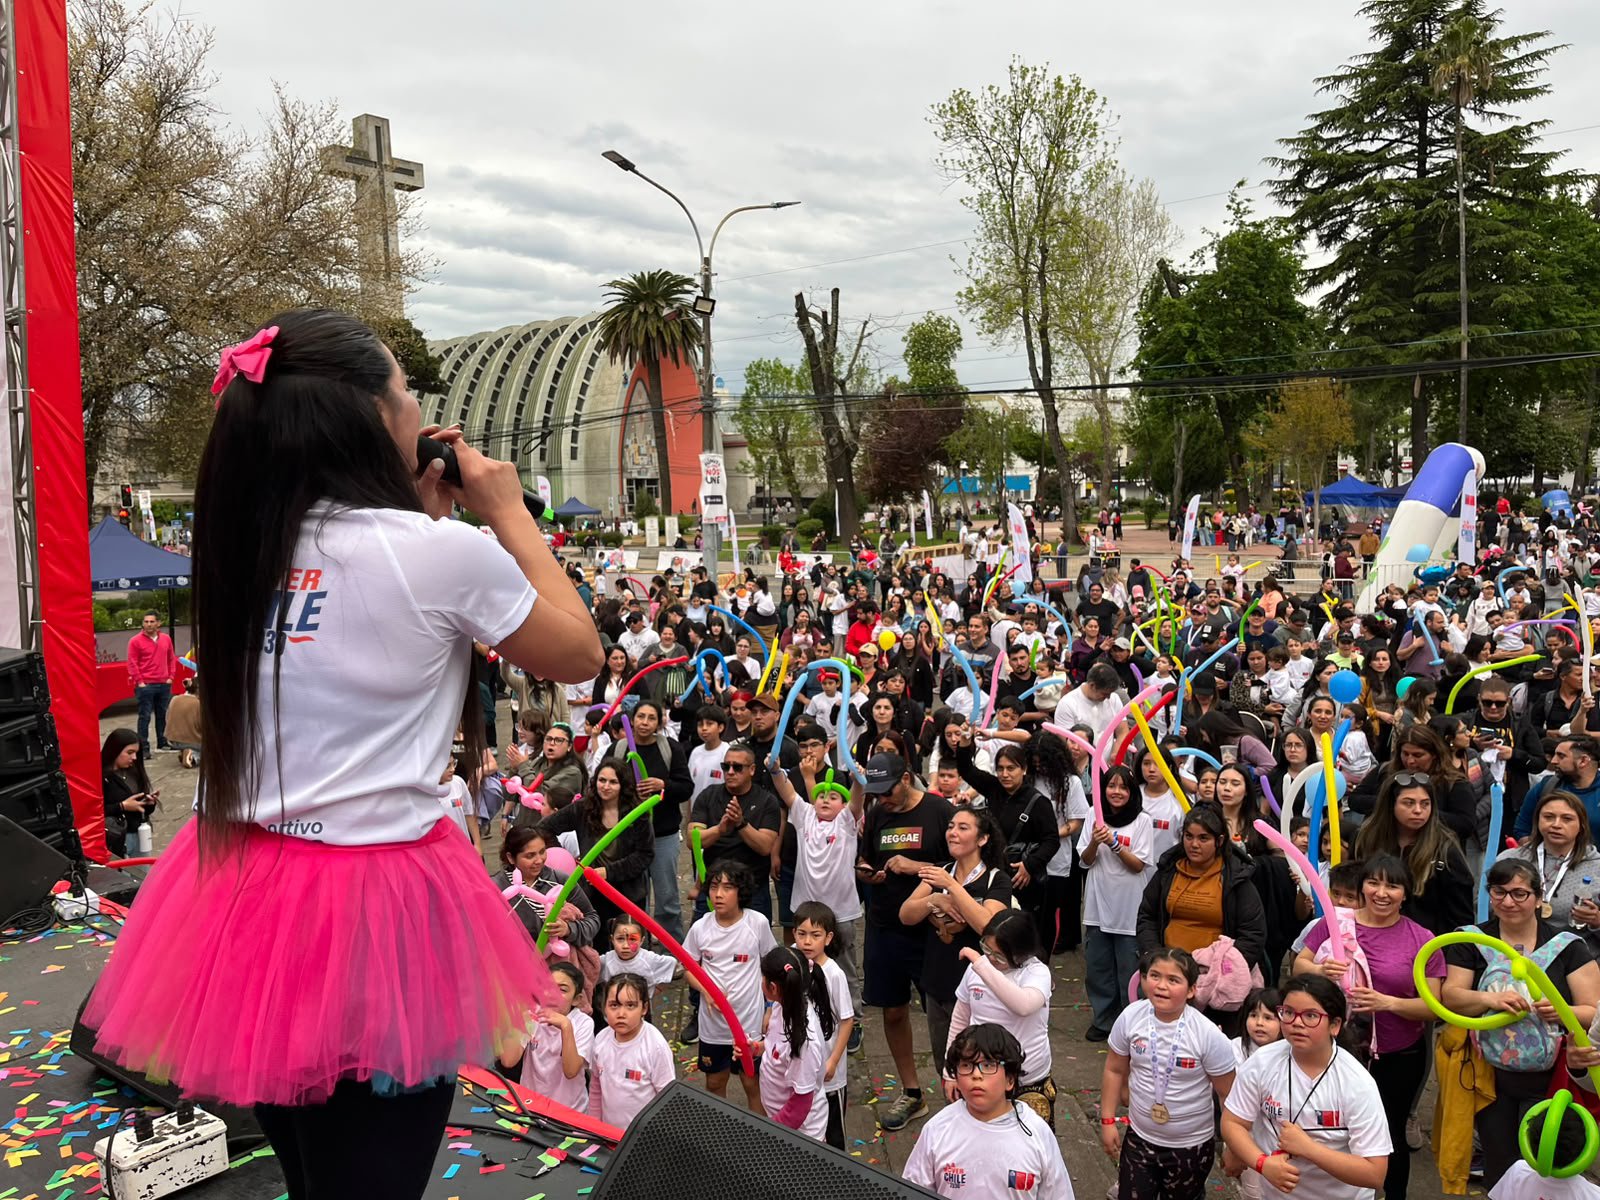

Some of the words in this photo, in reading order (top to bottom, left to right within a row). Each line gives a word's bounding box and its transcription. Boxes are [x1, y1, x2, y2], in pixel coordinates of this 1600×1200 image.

[267, 819, 323, 835] ortivo
[881, 833, 920, 844] REGGAE
[943, 1173, 966, 1184] CHILE
